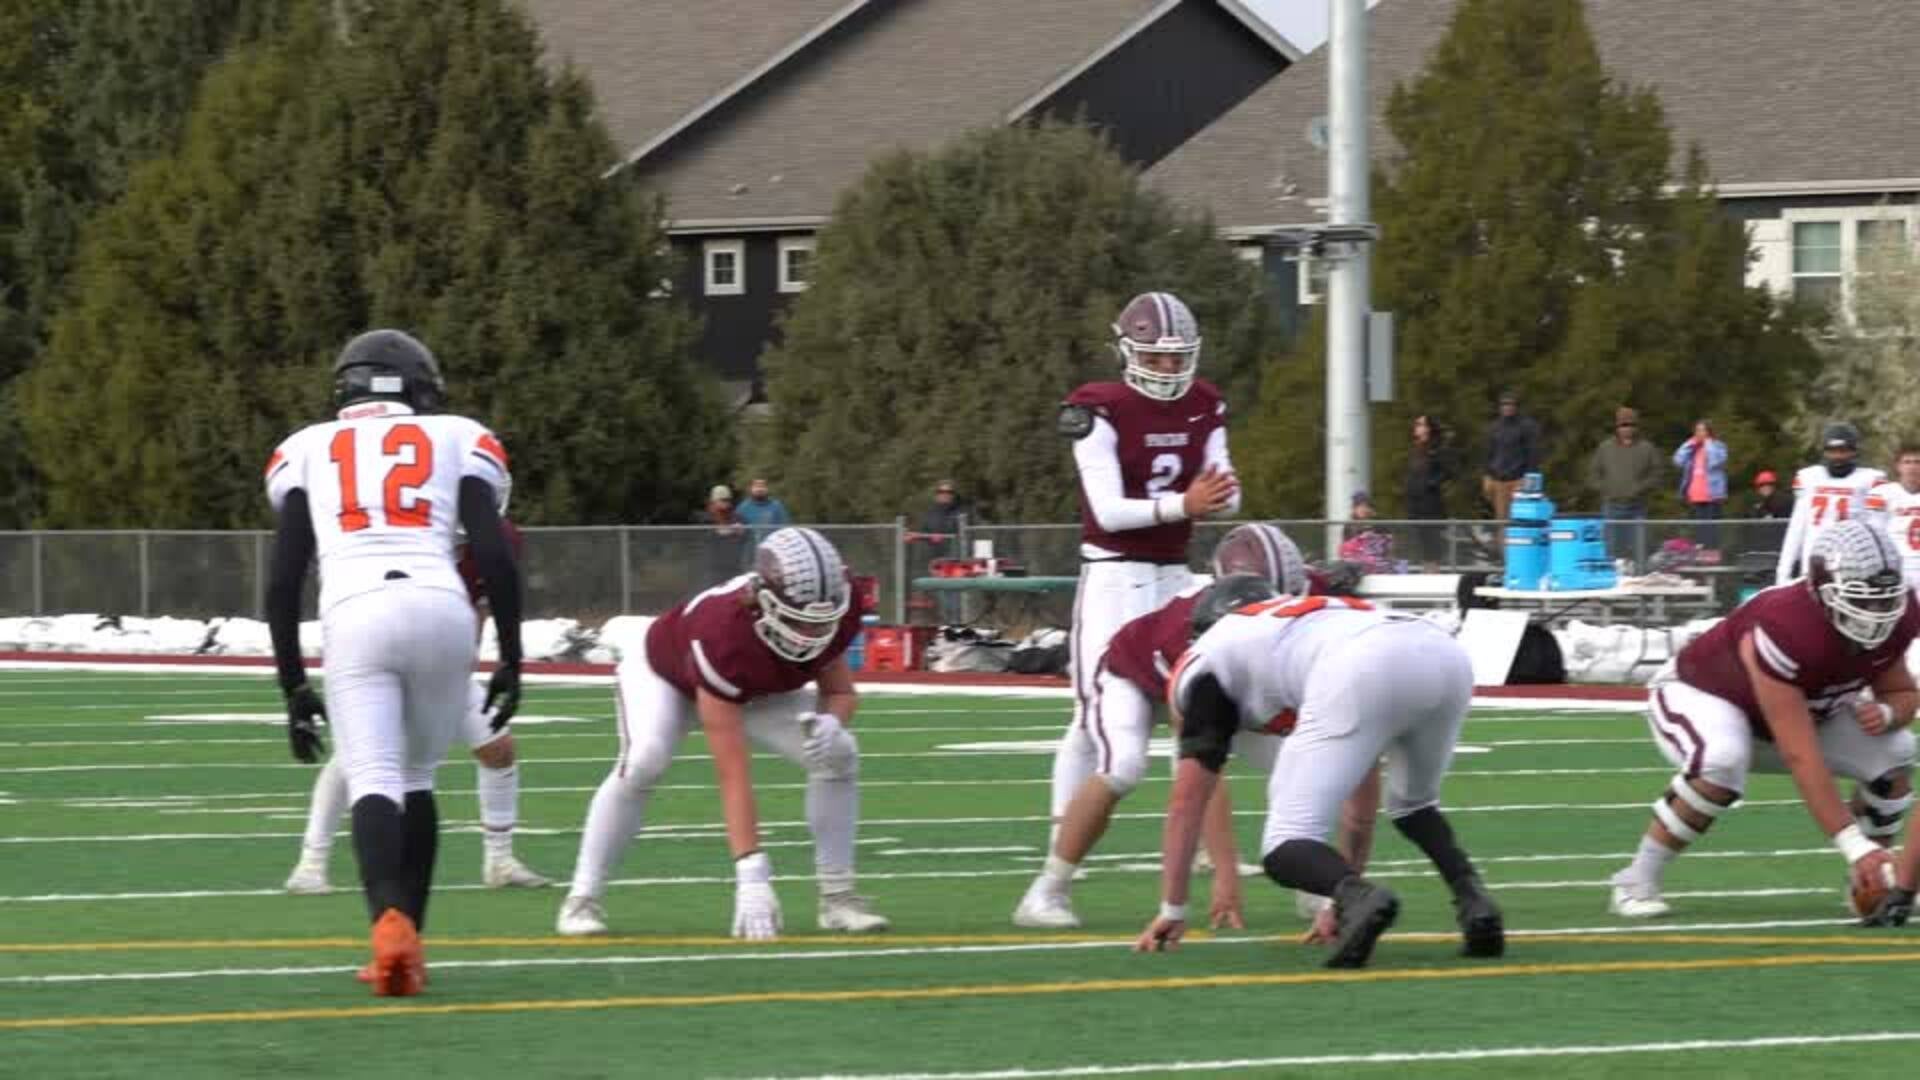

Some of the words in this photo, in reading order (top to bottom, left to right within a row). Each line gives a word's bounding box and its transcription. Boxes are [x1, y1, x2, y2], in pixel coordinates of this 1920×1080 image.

[329, 423, 433, 532] 12
[1146, 453, 1183, 500] 2
[1811, 496, 1852, 526] 71
